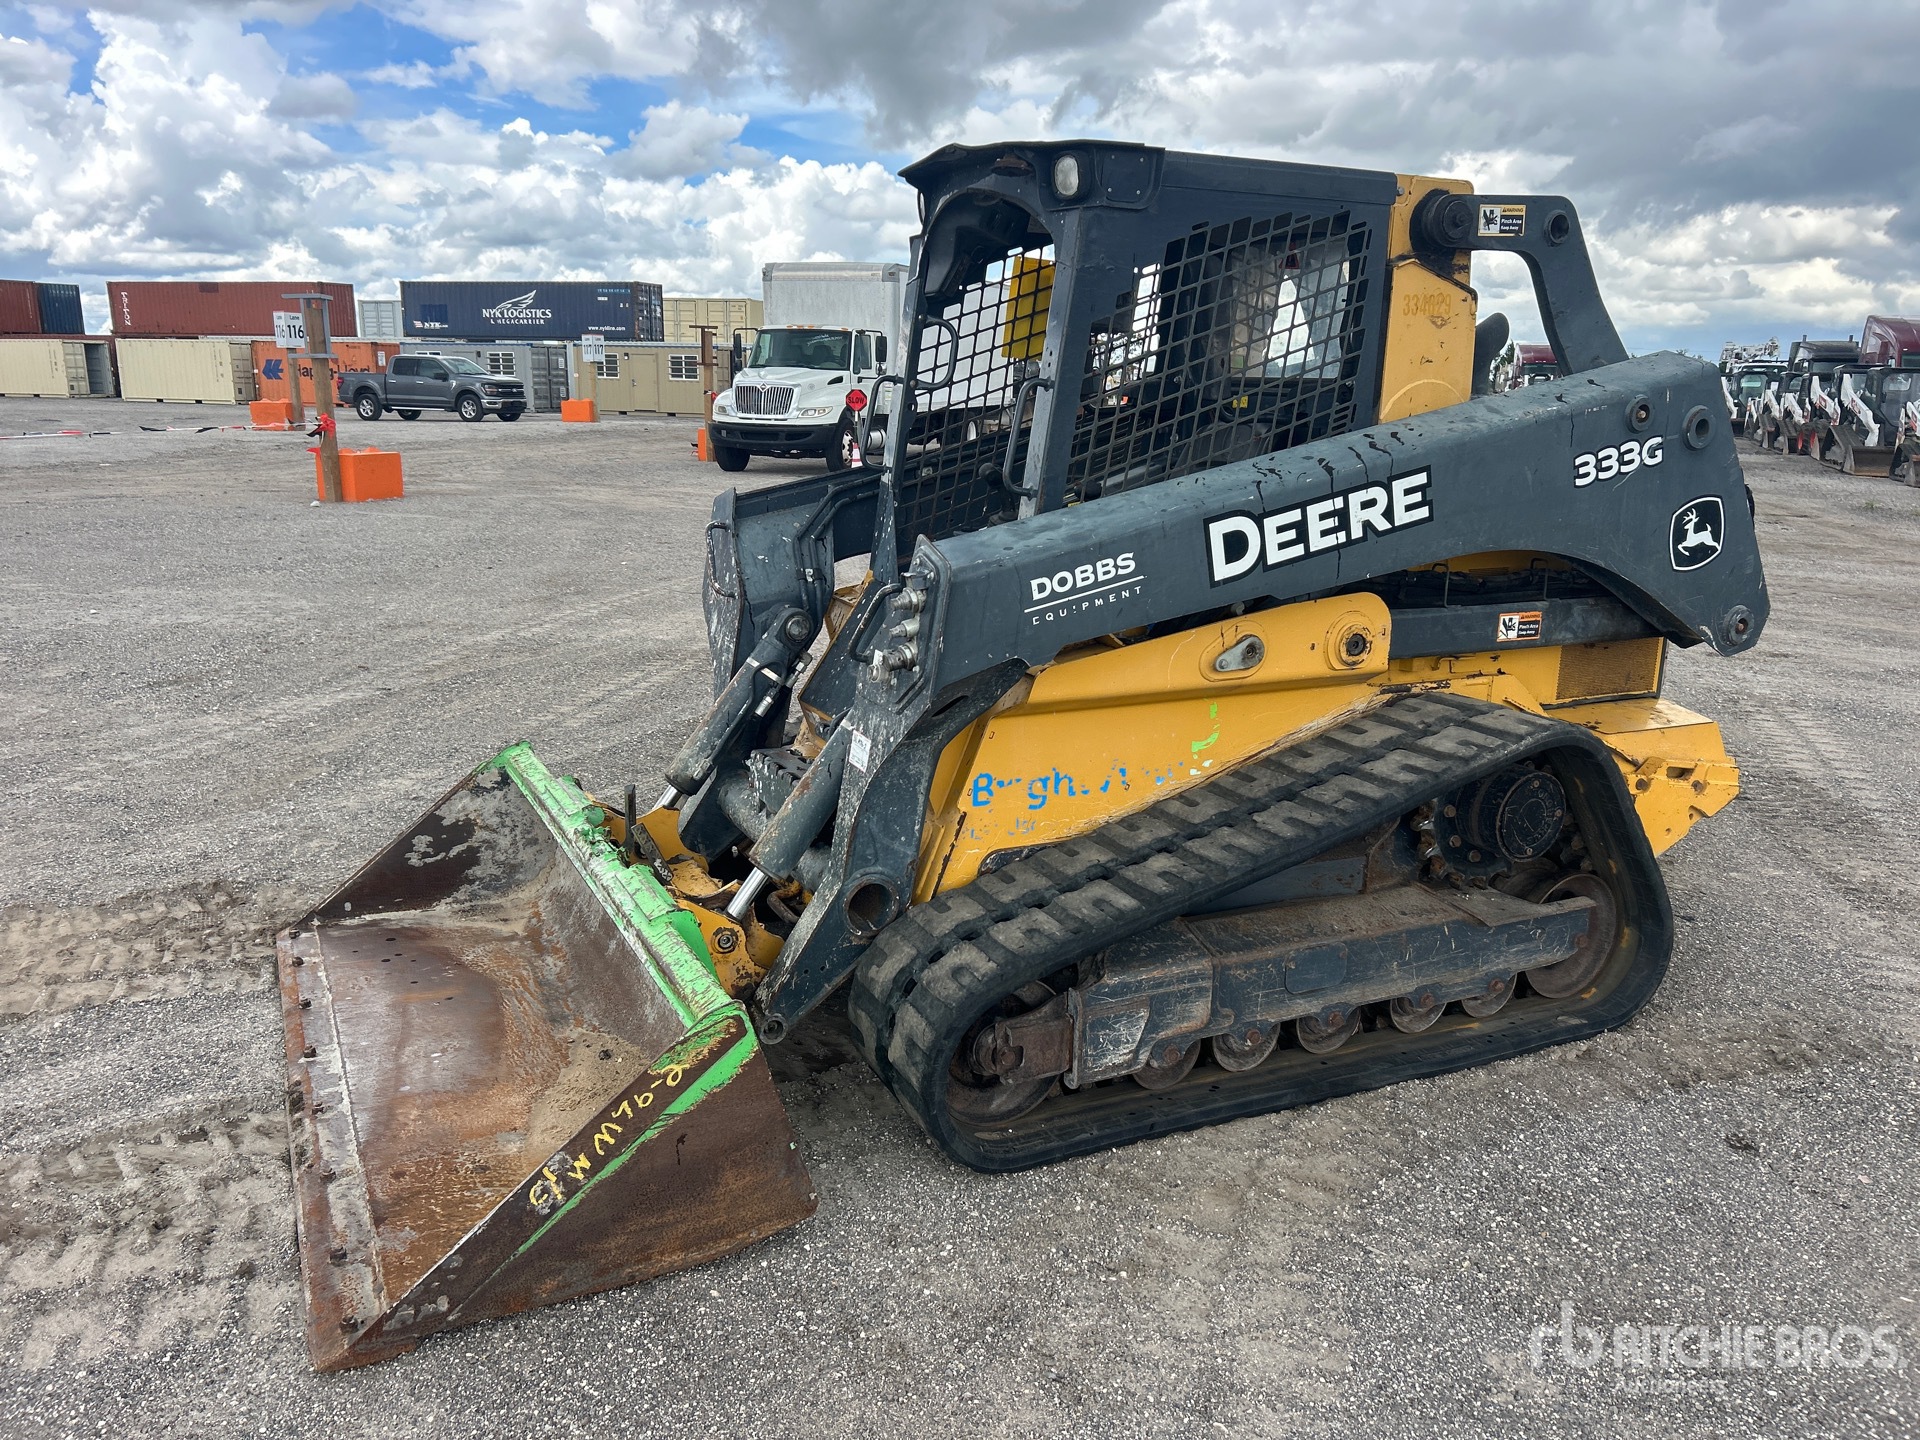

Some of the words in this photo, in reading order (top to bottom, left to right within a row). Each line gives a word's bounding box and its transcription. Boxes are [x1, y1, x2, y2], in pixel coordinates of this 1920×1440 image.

[121, 292, 131, 326] TRITON
[482, 309, 502, 318] NYK
[504, 309, 552, 318] LOGISTICS
[287, 325, 304, 338] 116
[594, 344, 603, 355] 117
[1574, 436, 1664, 487] 333G
[1208, 472, 1430, 582] DEERE
[1030, 552, 1136, 601] DOBBS
[1032, 586, 1142, 625] EQUIPMENT
